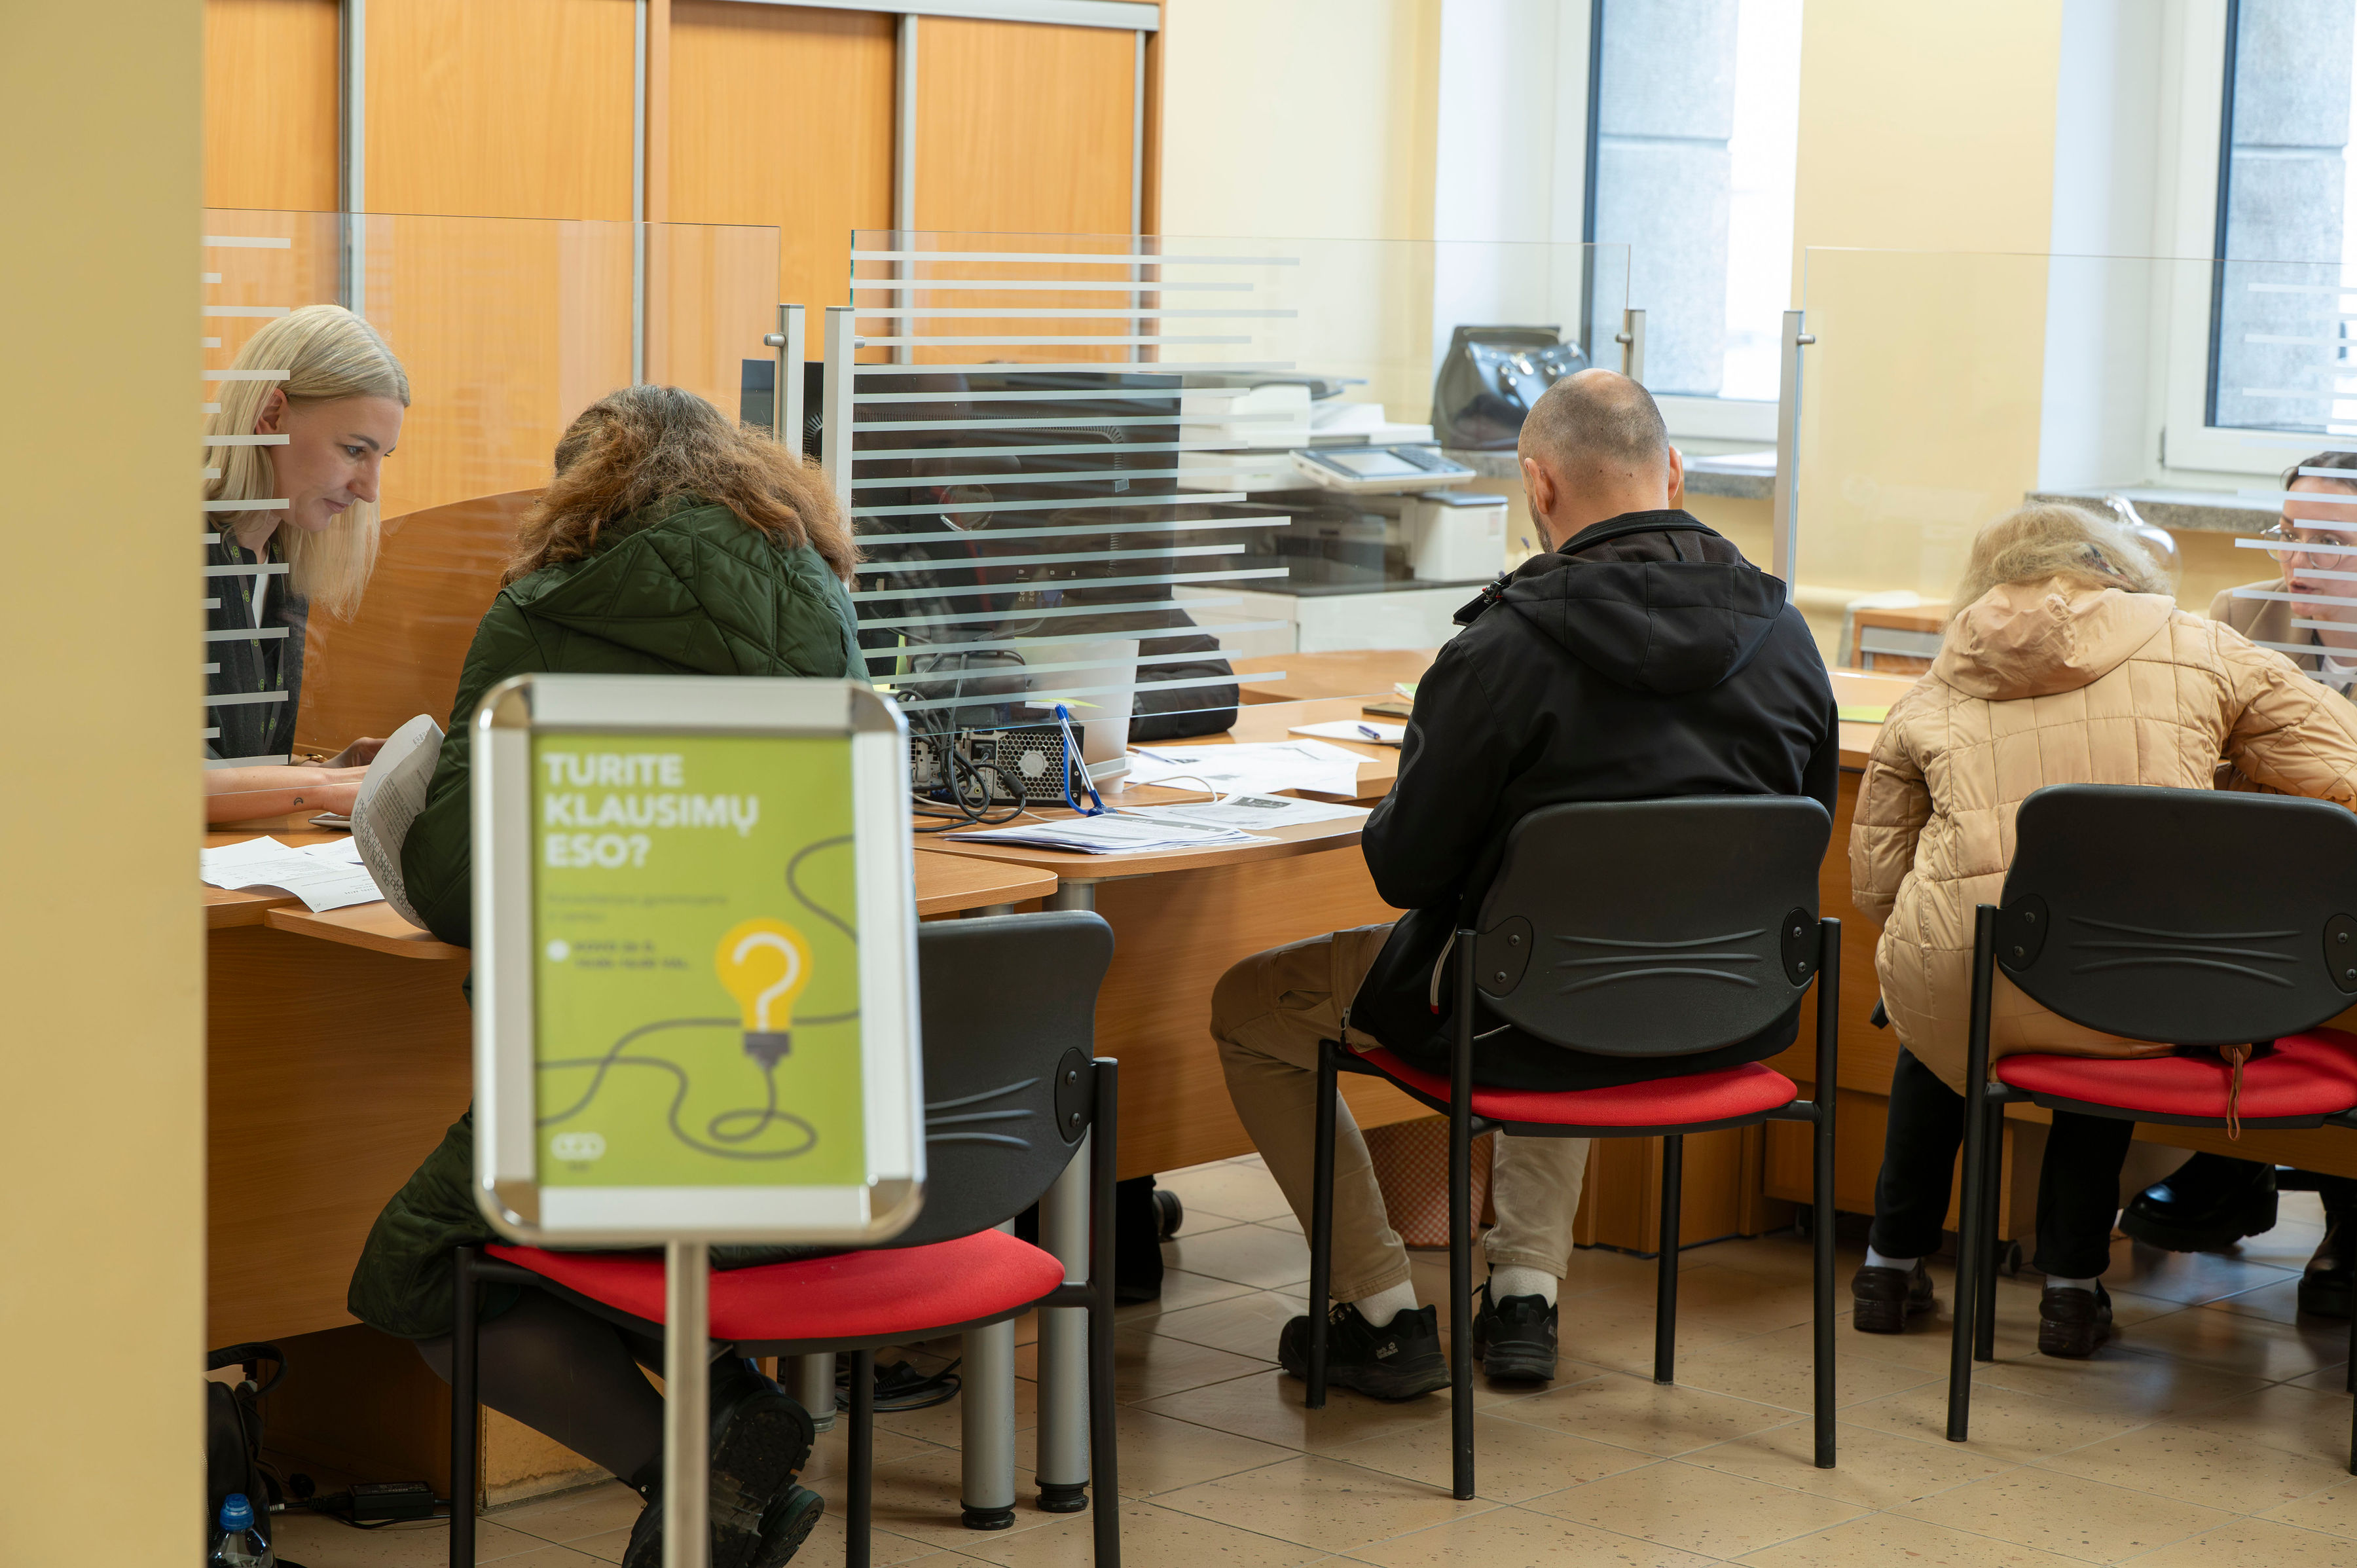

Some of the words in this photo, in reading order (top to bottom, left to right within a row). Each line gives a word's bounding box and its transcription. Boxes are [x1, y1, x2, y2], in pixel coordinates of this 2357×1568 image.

[543, 753, 683, 786] TURITE
[545, 794, 758, 837] KLAUSIMŲ
[545, 833, 651, 867] ESO?
